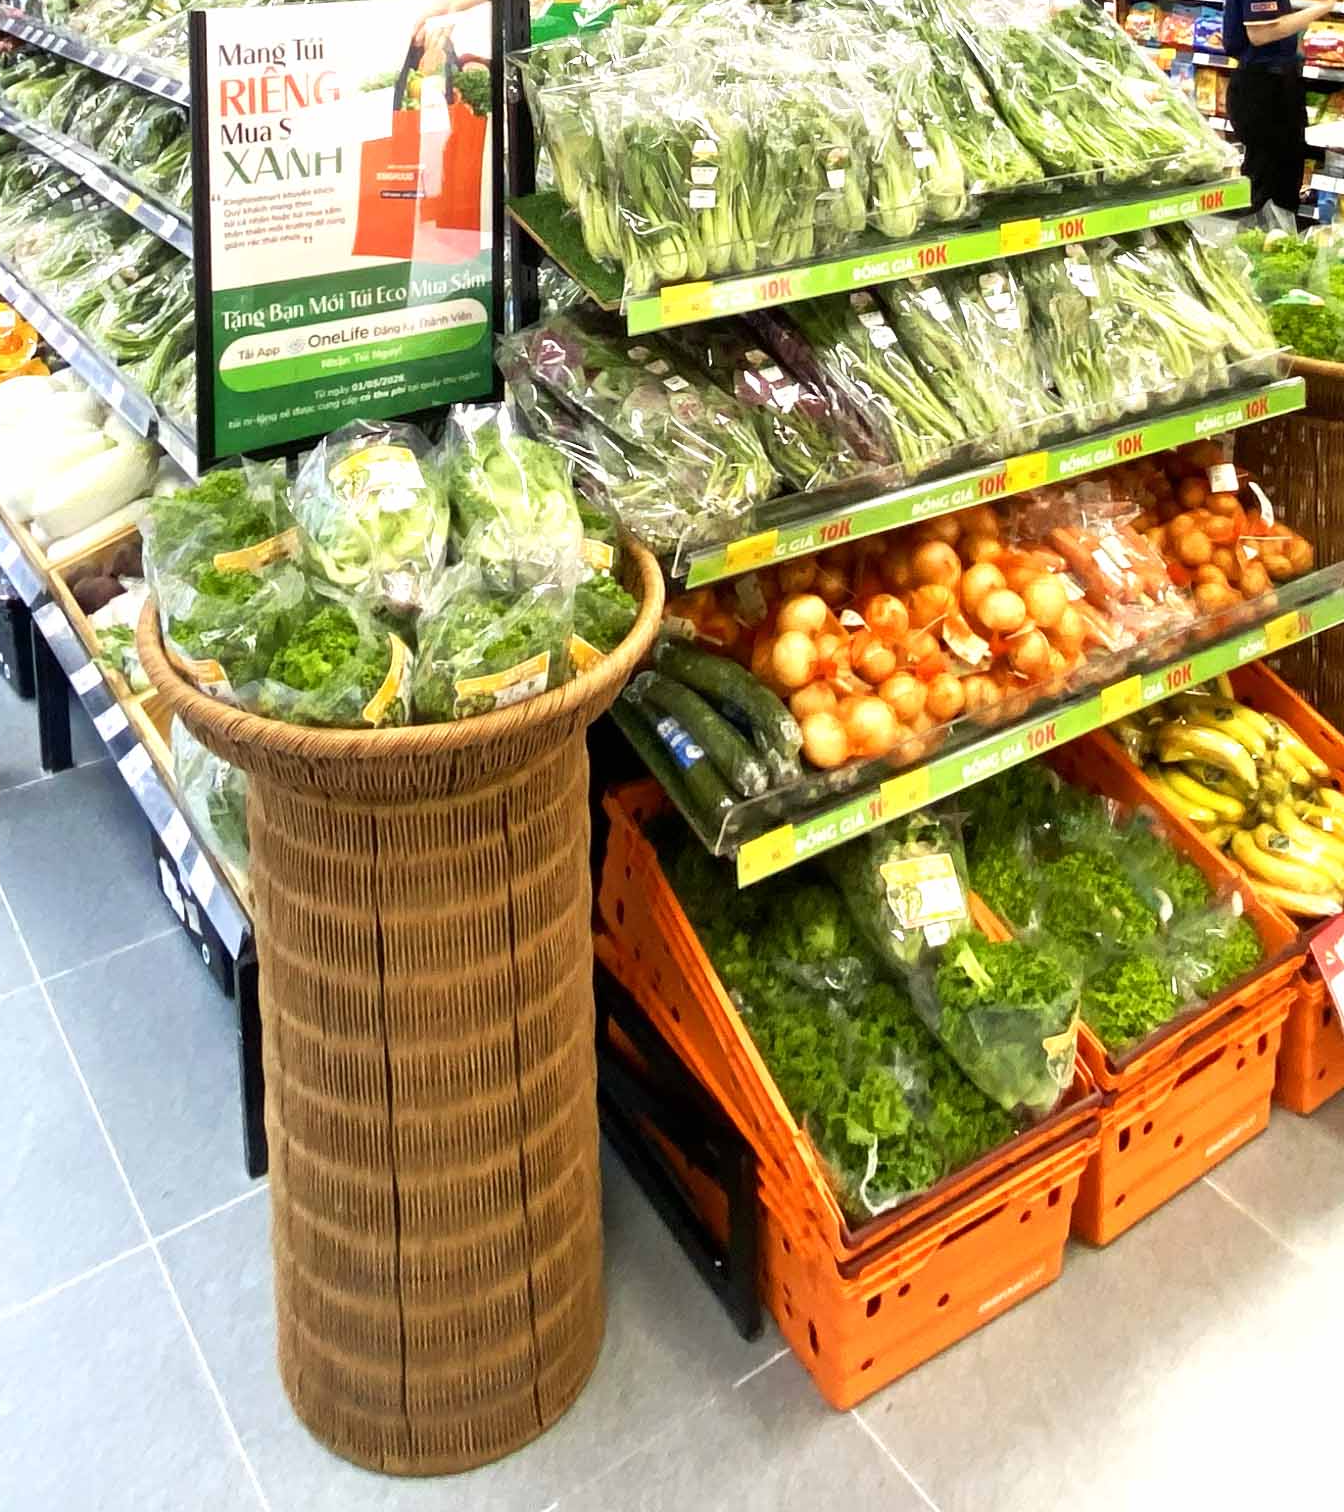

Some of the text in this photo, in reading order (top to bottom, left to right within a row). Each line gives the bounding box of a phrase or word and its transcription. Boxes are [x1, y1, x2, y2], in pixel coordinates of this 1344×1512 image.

[218, 37, 324, 68] Mang Túi
[220, 66, 341, 118] RIÊNG
[220, 122, 272, 145] Mua
[222, 146, 343, 188] XANH
[1199, 190, 1225, 211] 10K
[1058, 217, 1085, 240] 10K
[917, 244, 948, 268] 10K
[221, 267, 487, 332] Tặng Bạn Mới Túi Eco Mua Sắm
[759, 278, 792, 299] 10K
[256, 346, 281, 358] App
[307, 325, 370, 349] OneLife
[450, 311, 473, 322] Viên
[1246, 394, 1269, 419] 10K
[1116, 432, 1143, 457] 10K
[978, 472, 1007, 498] 10K
[820, 518, 853, 542] 10K
[1166, 663, 1193, 690] 10K
[1026, 722, 1057, 752] 10K
